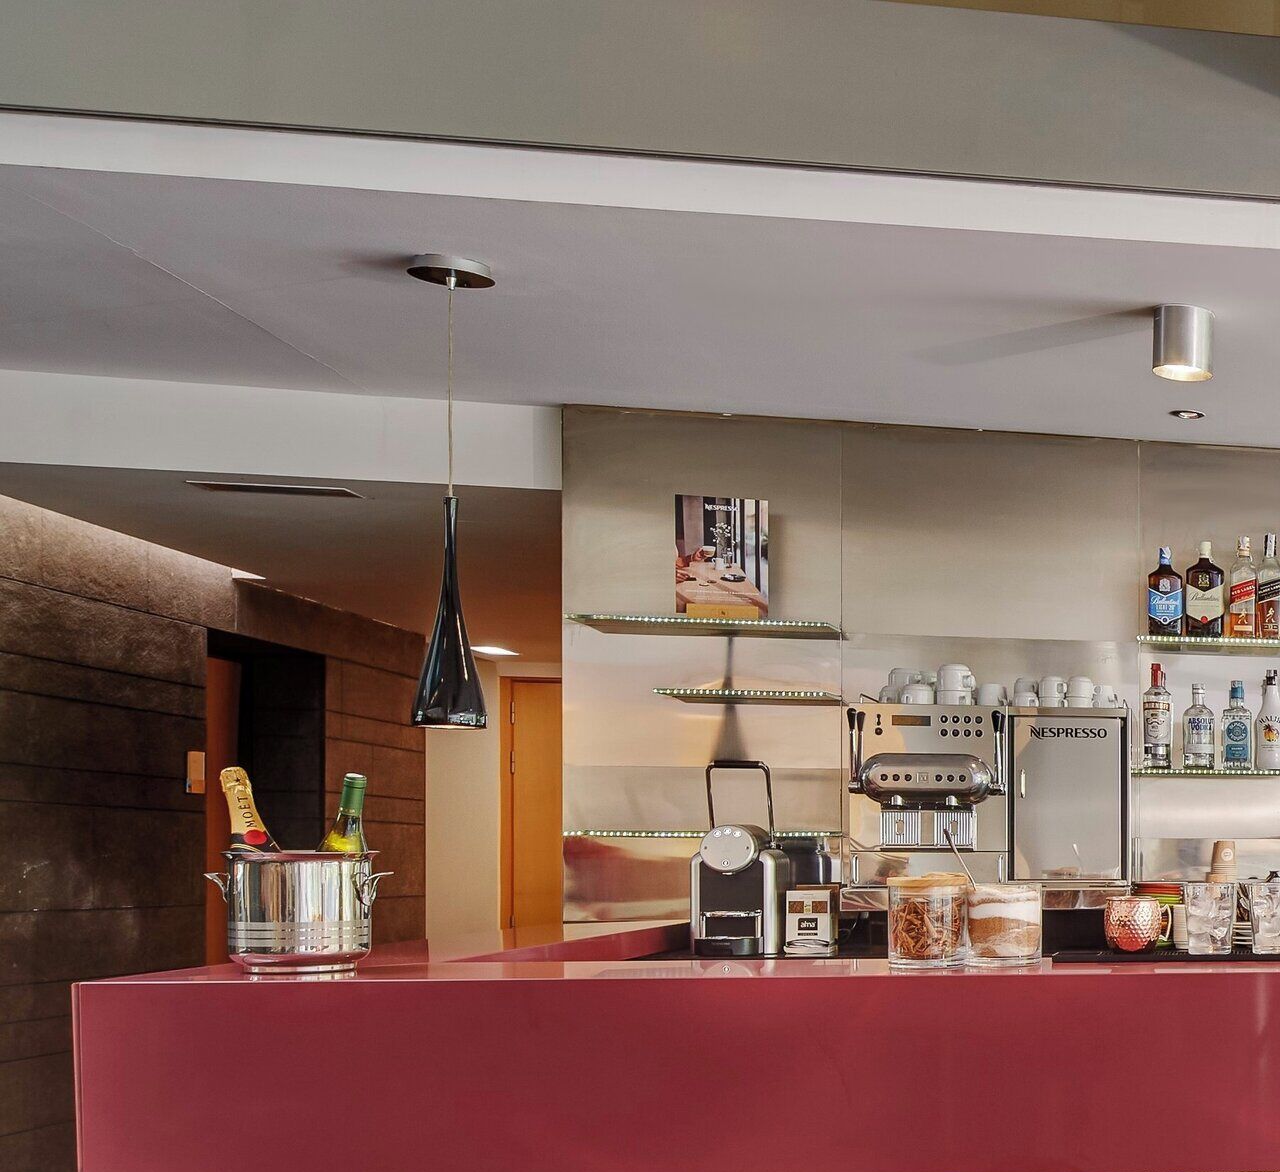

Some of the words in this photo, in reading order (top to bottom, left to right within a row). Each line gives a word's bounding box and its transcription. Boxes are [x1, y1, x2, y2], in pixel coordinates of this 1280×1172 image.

[704, 503, 740, 512] NESPRESSO
[1027, 725, 1107, 740] NESPRESSO
[800, 920, 816, 928] alma
